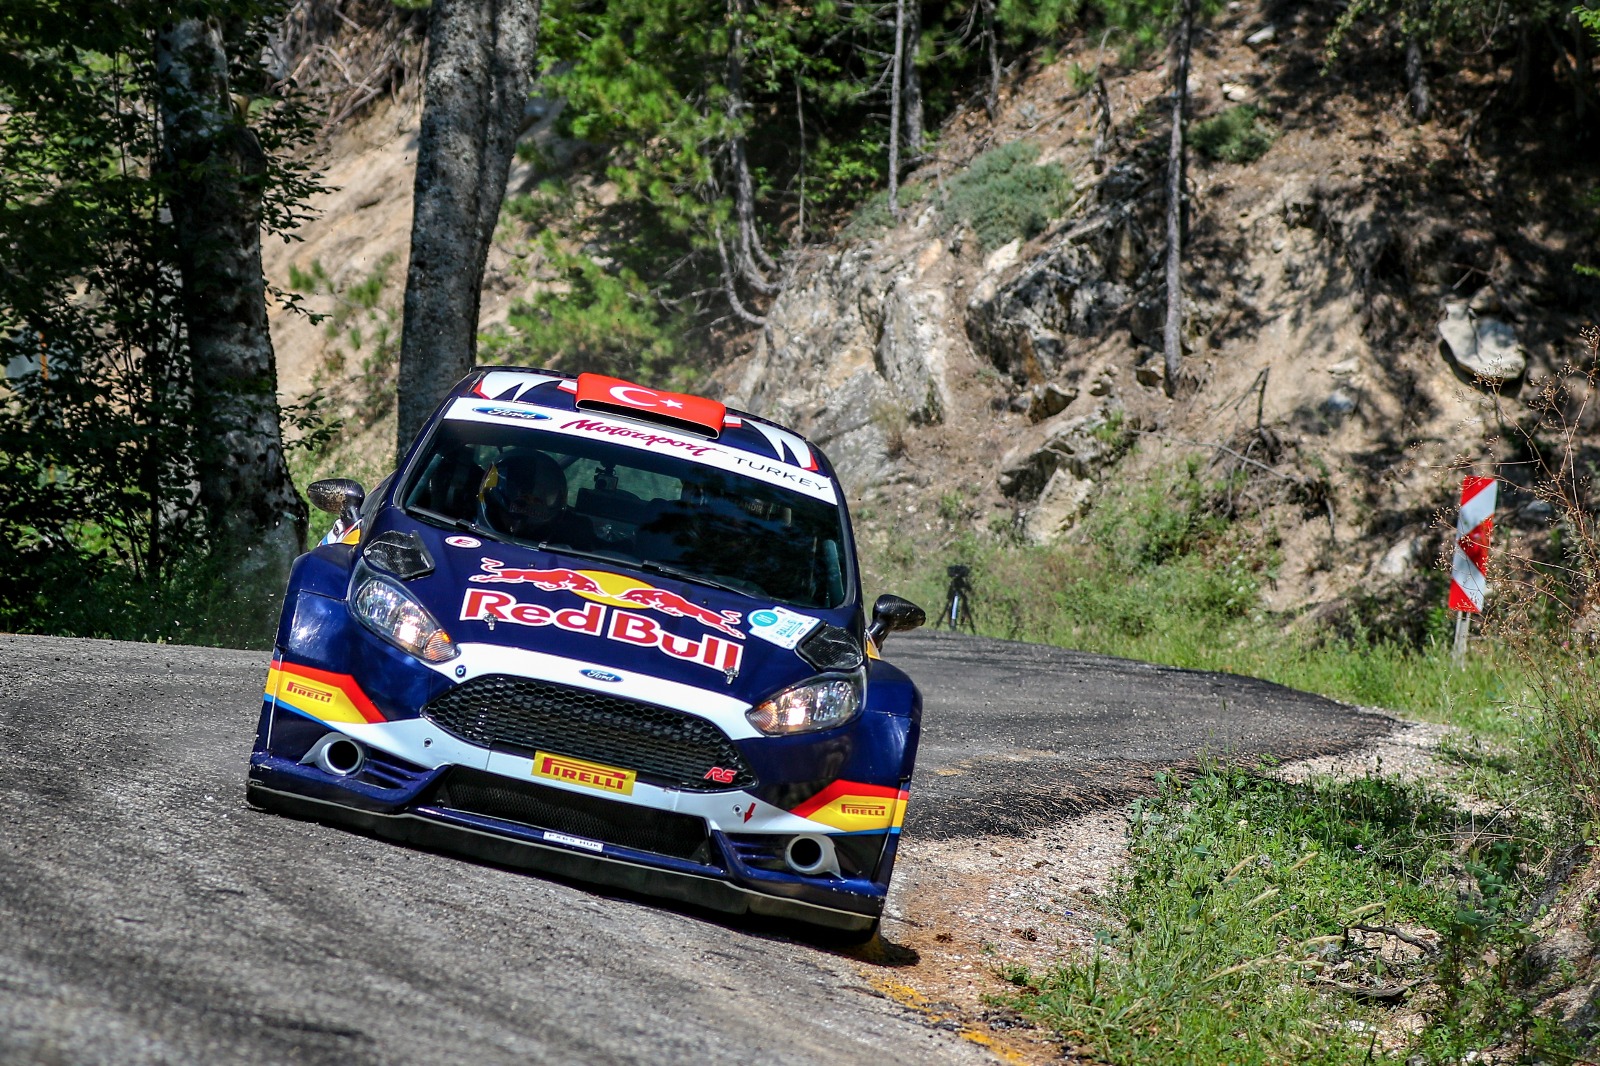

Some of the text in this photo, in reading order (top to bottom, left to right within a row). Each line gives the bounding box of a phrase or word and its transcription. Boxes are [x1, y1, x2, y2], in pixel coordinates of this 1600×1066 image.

[487, 407, 538, 419] Ford
[559, 419, 829, 491] Motorsport TURKEY
[460, 588, 743, 674] Red Bull
[286, 681, 333, 703] PIRELLI
[540, 756, 627, 791] PIRELLI
[703, 766, 738, 785] RS
[841, 803, 886, 817] PIRELLI
